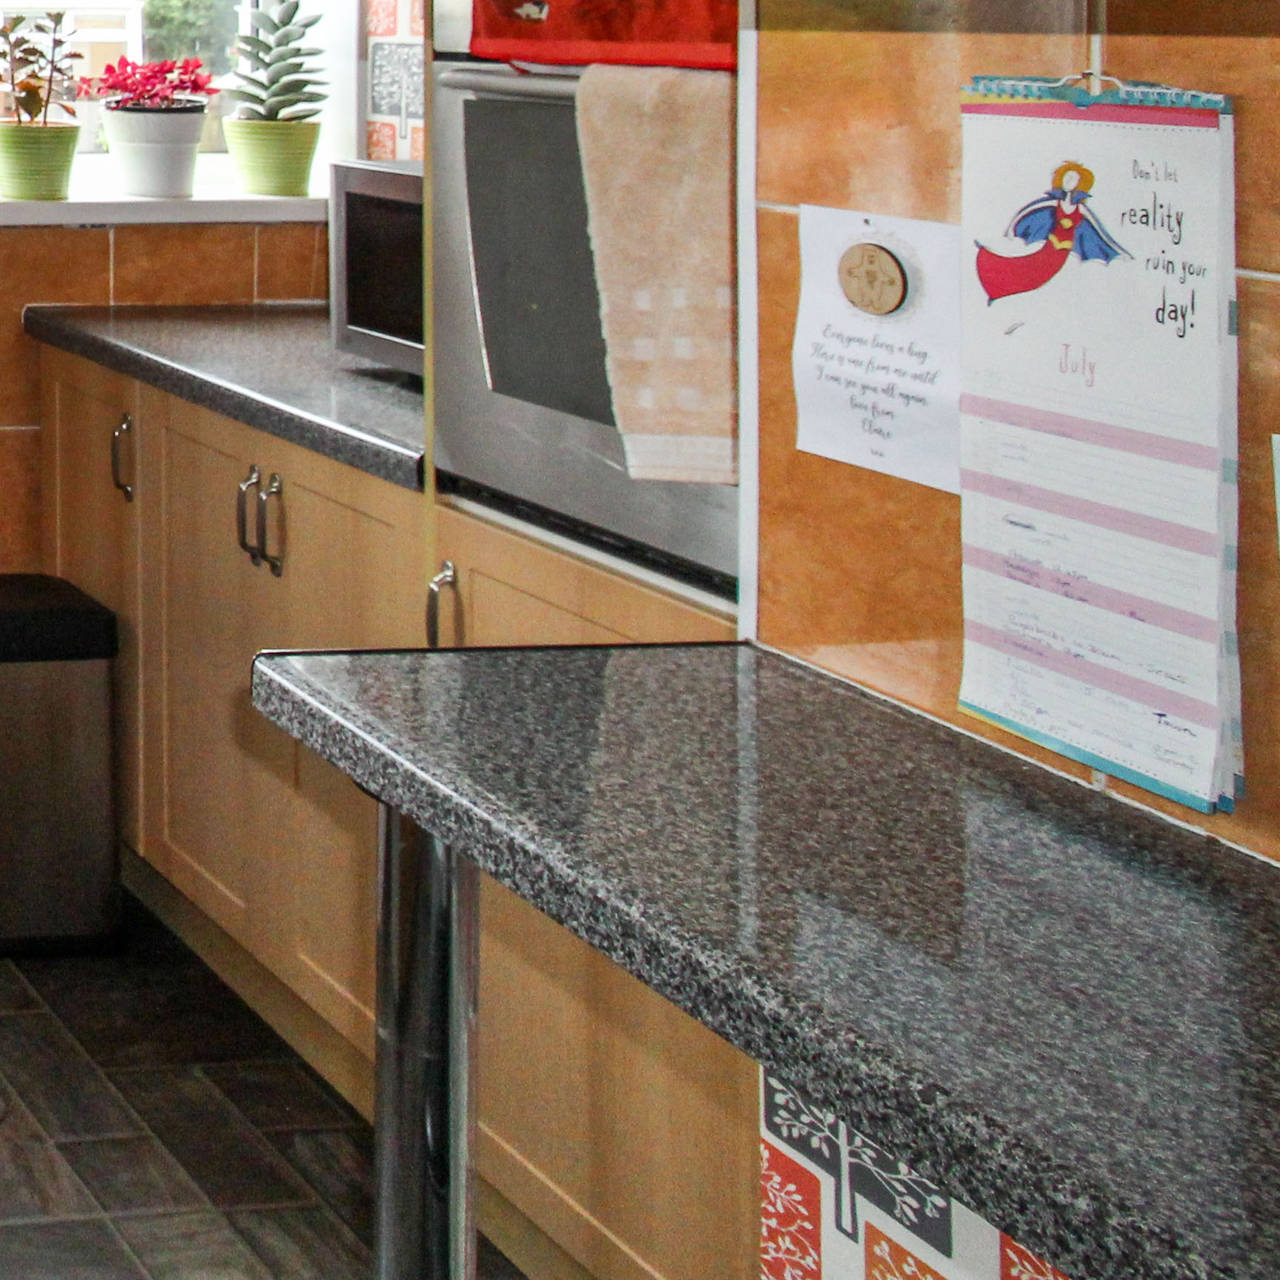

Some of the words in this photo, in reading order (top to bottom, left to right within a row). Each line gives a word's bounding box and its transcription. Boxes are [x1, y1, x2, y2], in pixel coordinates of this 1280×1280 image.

[1121, 191, 1184, 245] reality
[1145, 249, 1175, 275] ruin
[1179, 261, 1207, 285] your
[1155, 286, 1195, 338] day!
[1058, 343, 1096, 388] July
